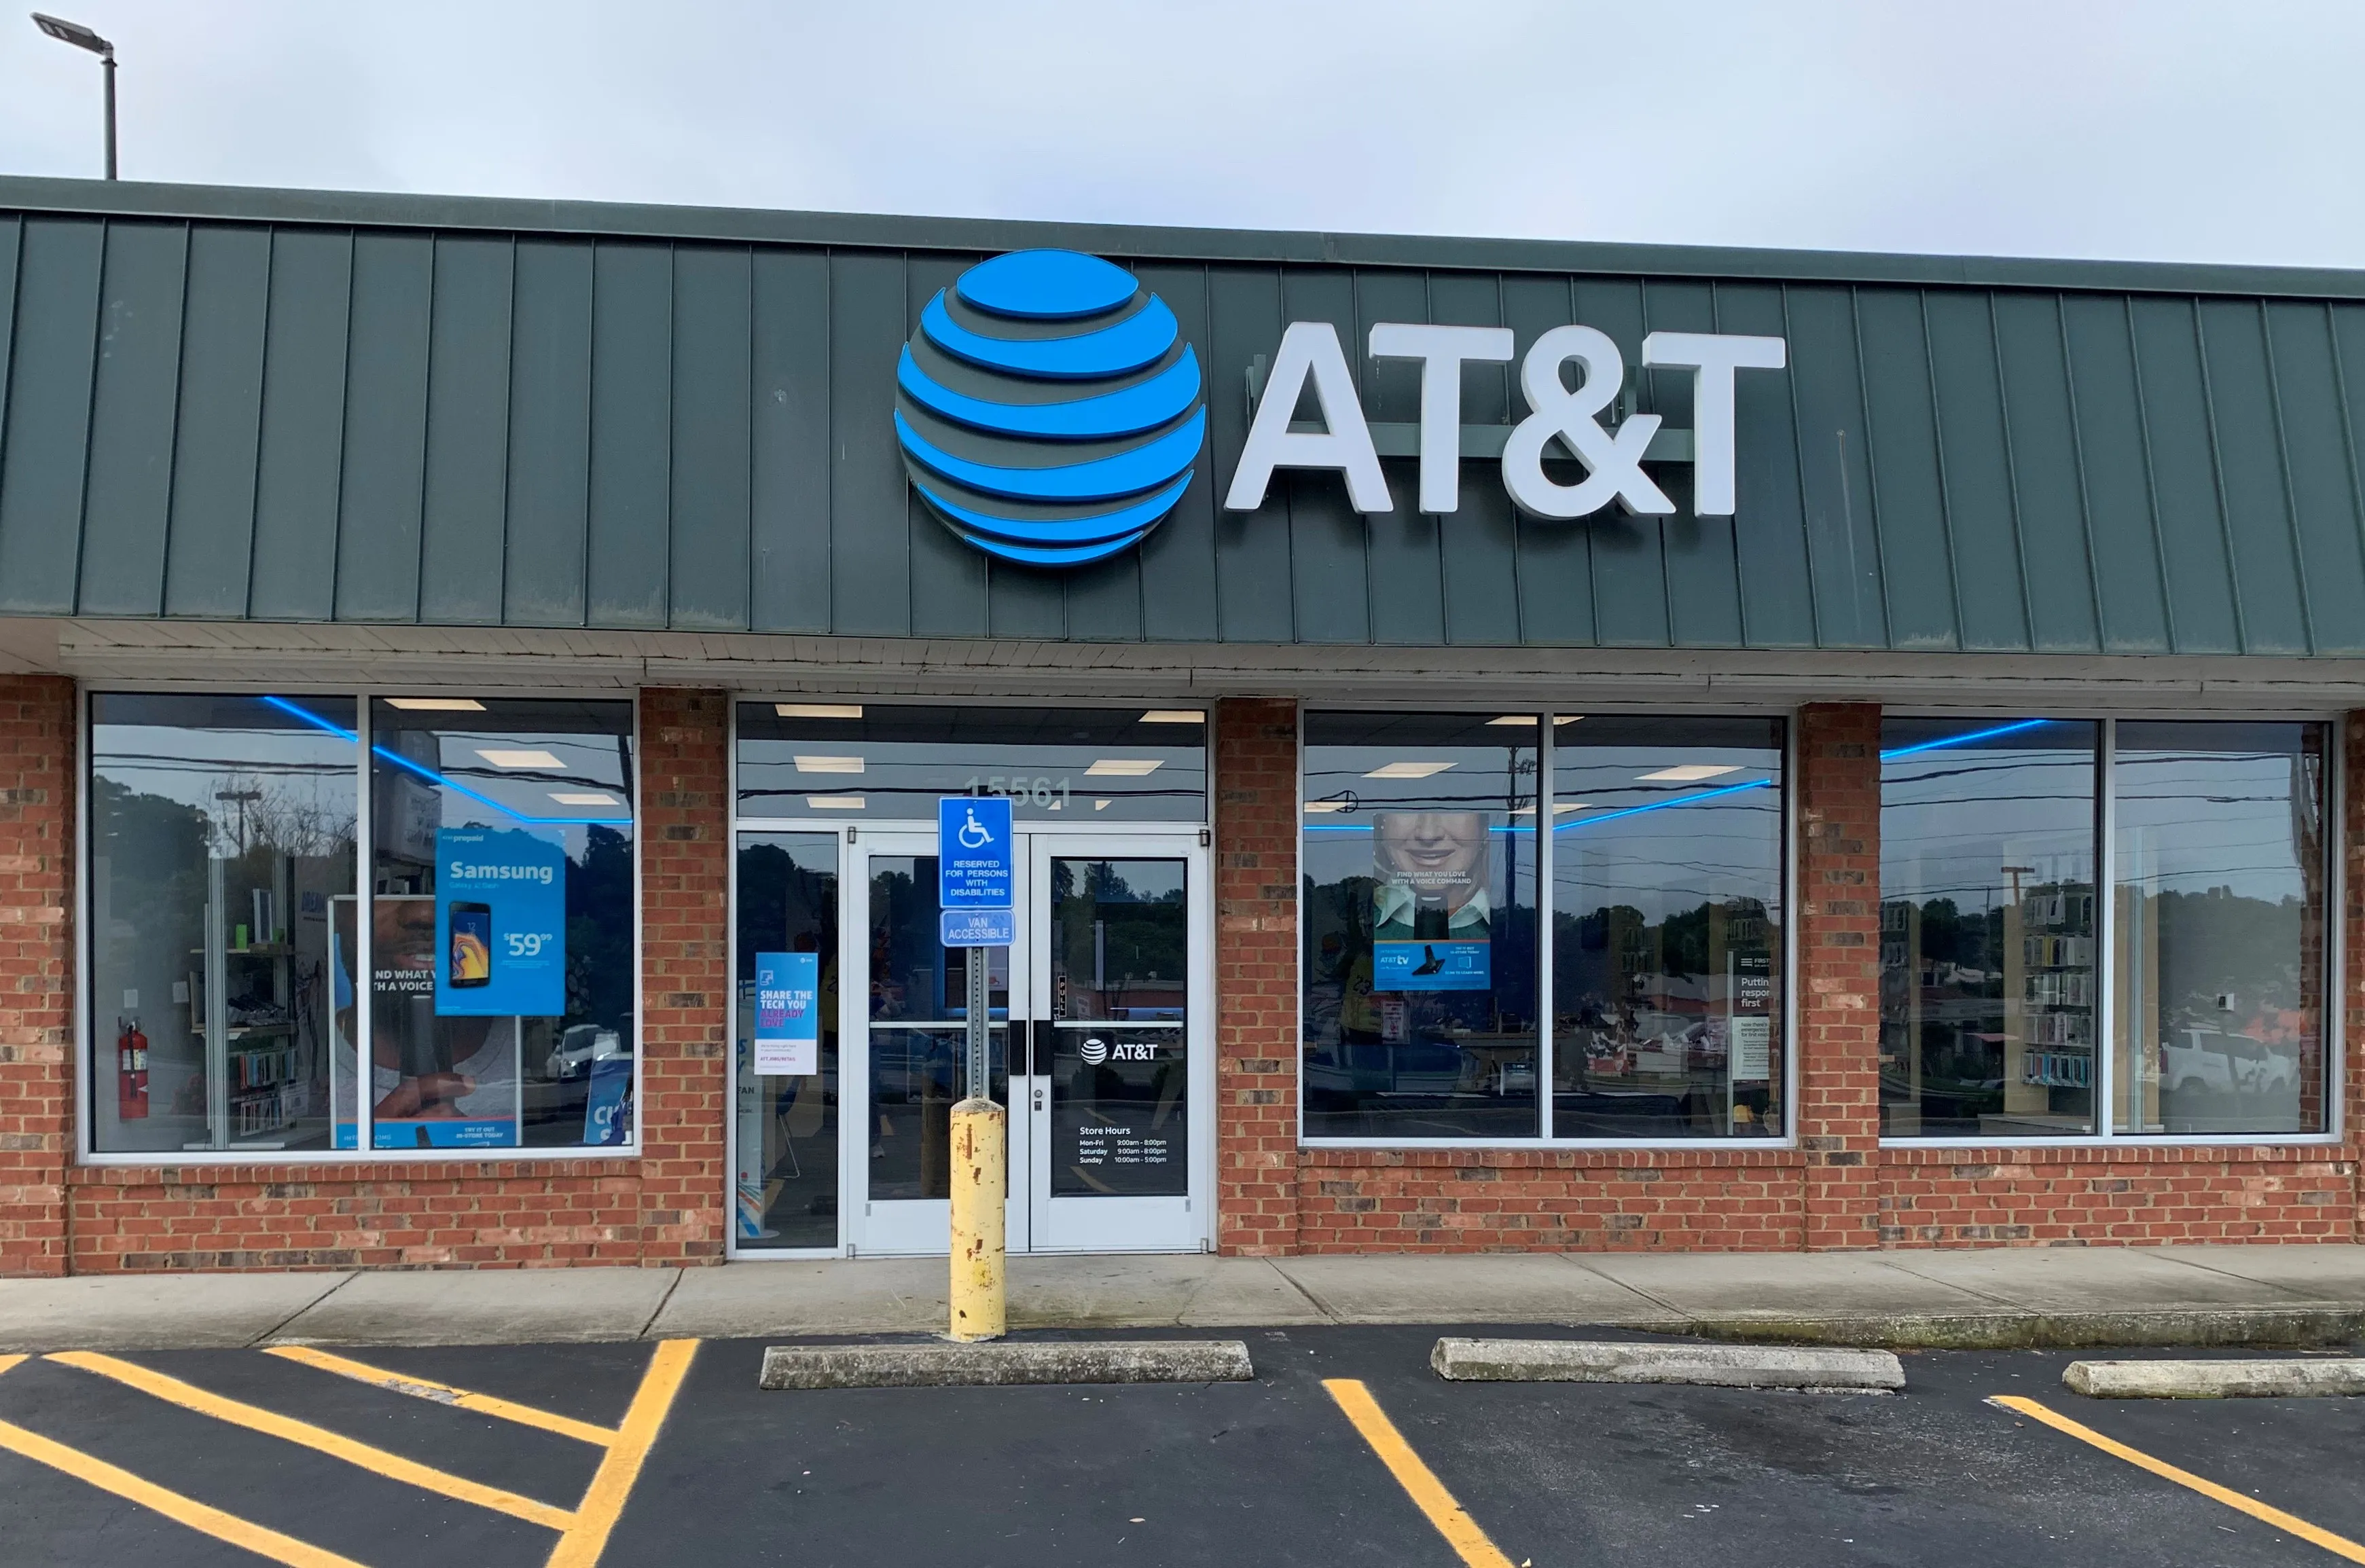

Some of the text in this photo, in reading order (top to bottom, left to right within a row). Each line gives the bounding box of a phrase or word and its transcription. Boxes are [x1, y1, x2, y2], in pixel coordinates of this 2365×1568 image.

[1225, 322, 1785, 520] AT&T
[964, 776, 1070, 807] 15561
[450, 861, 553, 885] Samsung
[968, 918, 988, 928] VAN
[948, 928, 1009, 940] ACCESSIBLE
[1396, 955, 1409, 965] tv
[394, 970, 428, 979] WHAT
[389, 982, 397, 991] A
[399, 981, 433, 991] VOICE
[1741, 978, 1769, 986] Puttin
[760, 991, 812, 1000] SHARE THE
[760, 1000, 806, 1009] TECH YOU
[1741, 998, 1761, 1007] first
[761, 1009, 804, 1018] ALREADY
[760, 1019, 784, 1027] LOVE
[1112, 1044, 1158, 1060] AT&T
[1079, 1127, 1130, 1135] Store Hours
